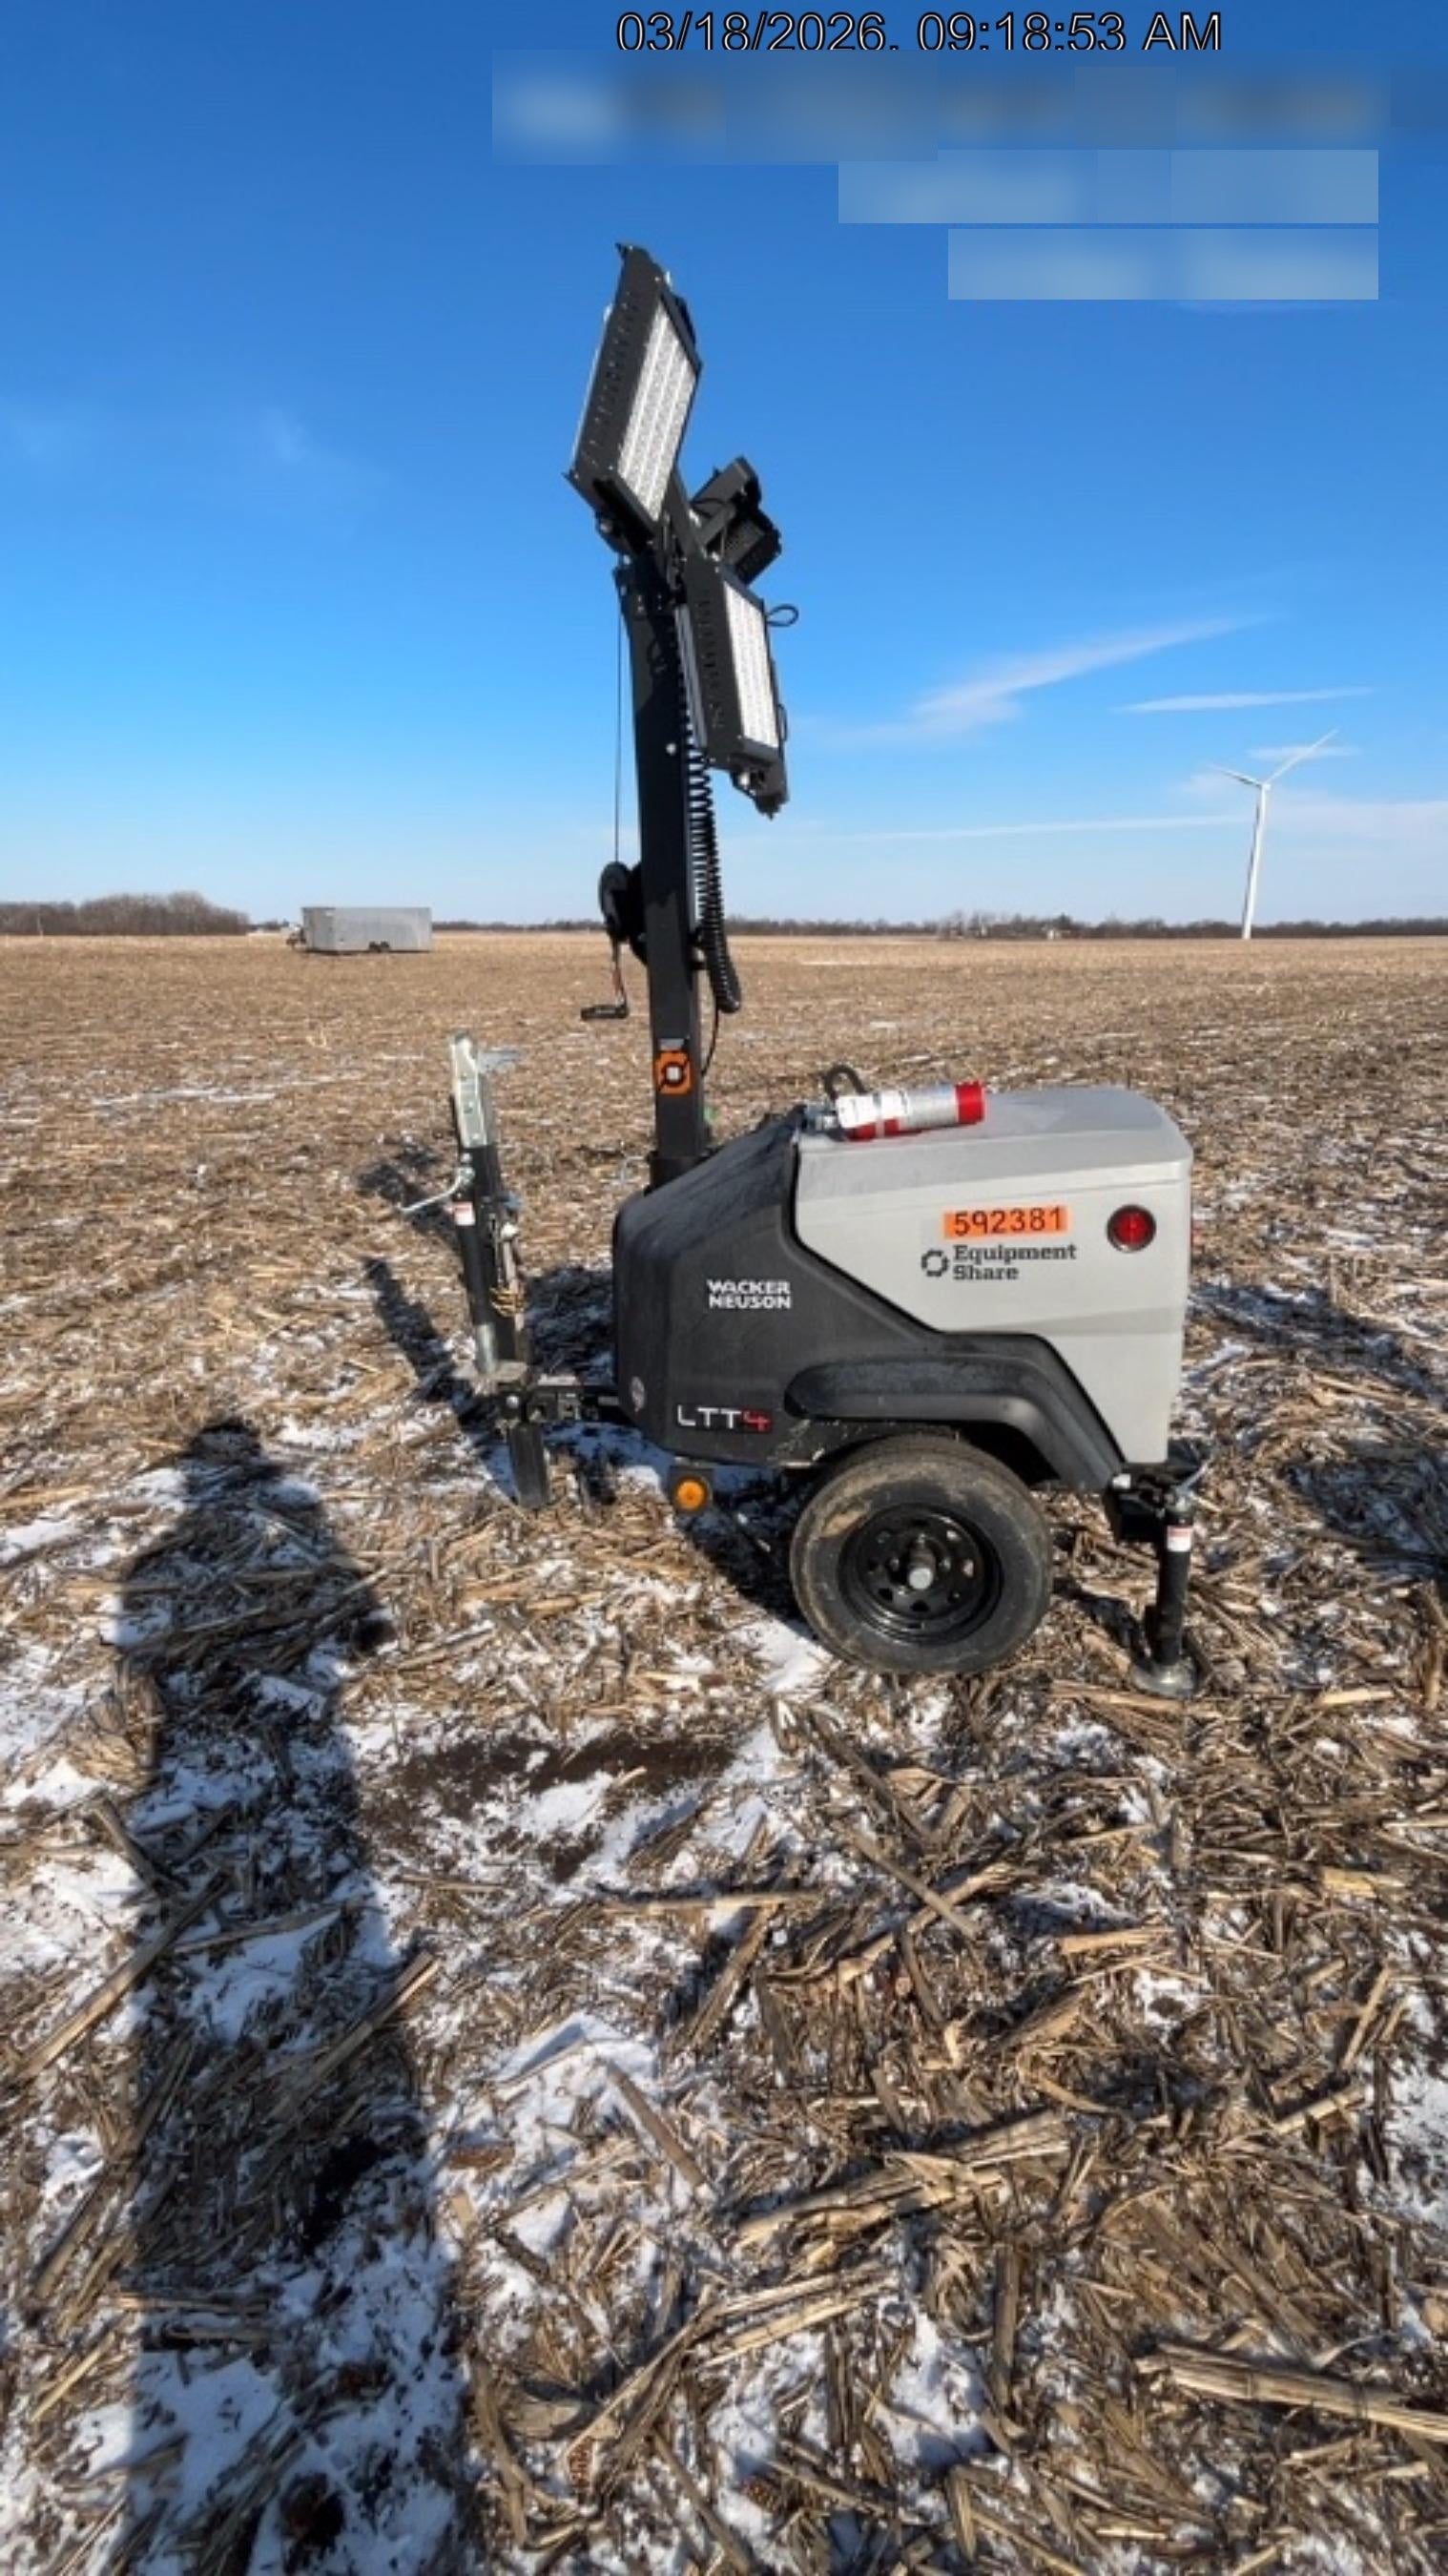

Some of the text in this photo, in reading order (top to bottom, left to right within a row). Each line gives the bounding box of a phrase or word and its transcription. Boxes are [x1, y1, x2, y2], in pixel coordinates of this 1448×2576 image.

[954, 1206, 1062, 1236] 592381
[953, 1244, 1077, 1264] Equipment
[953, 1264, 1019, 1280] Share
[707, 1279, 790, 1294] WACKER
[709, 1295, 791, 1309] NEUSON
[677, 1403, 770, 1431] LTT4
